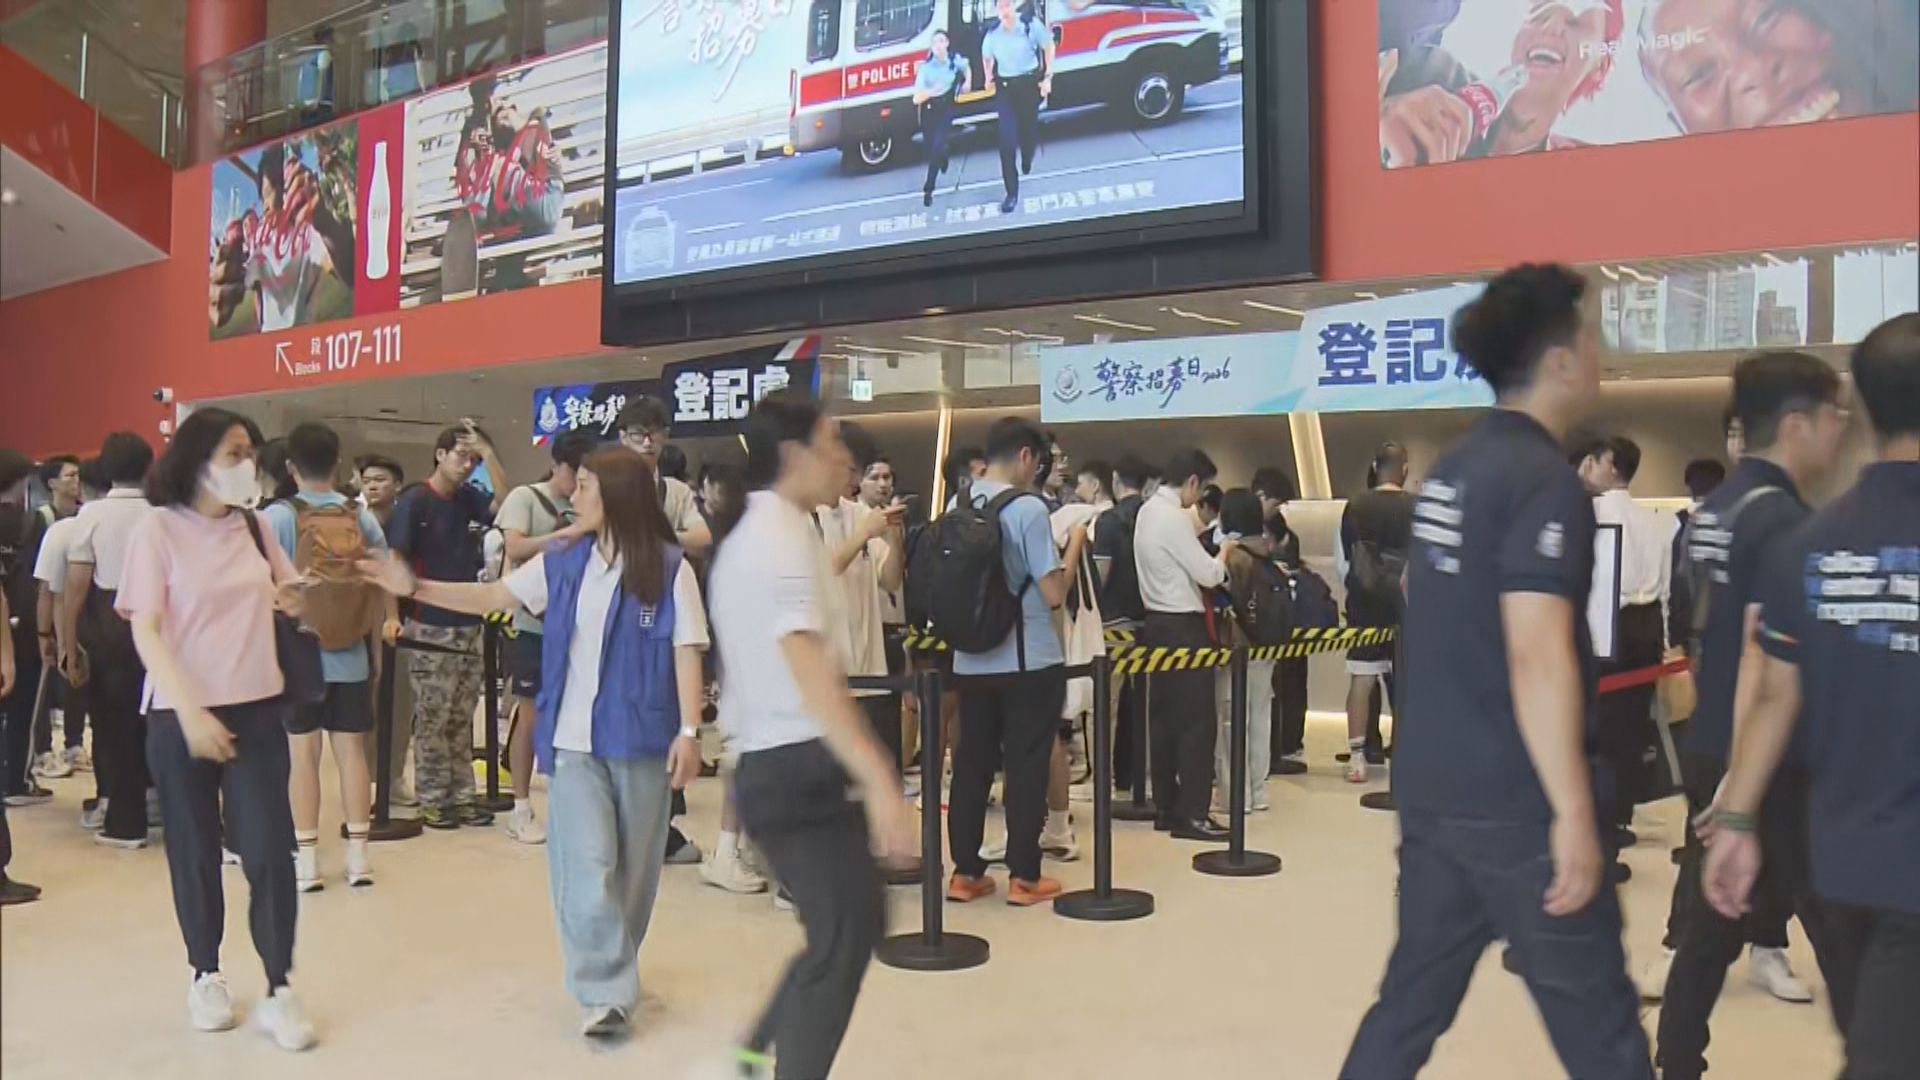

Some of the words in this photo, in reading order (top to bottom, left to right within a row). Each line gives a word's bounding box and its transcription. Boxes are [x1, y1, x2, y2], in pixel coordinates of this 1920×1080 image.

[861, 62, 910, 87] POLICE
[325, 324, 401, 371] 107-111
[1317, 318, 1482, 388] 登記
